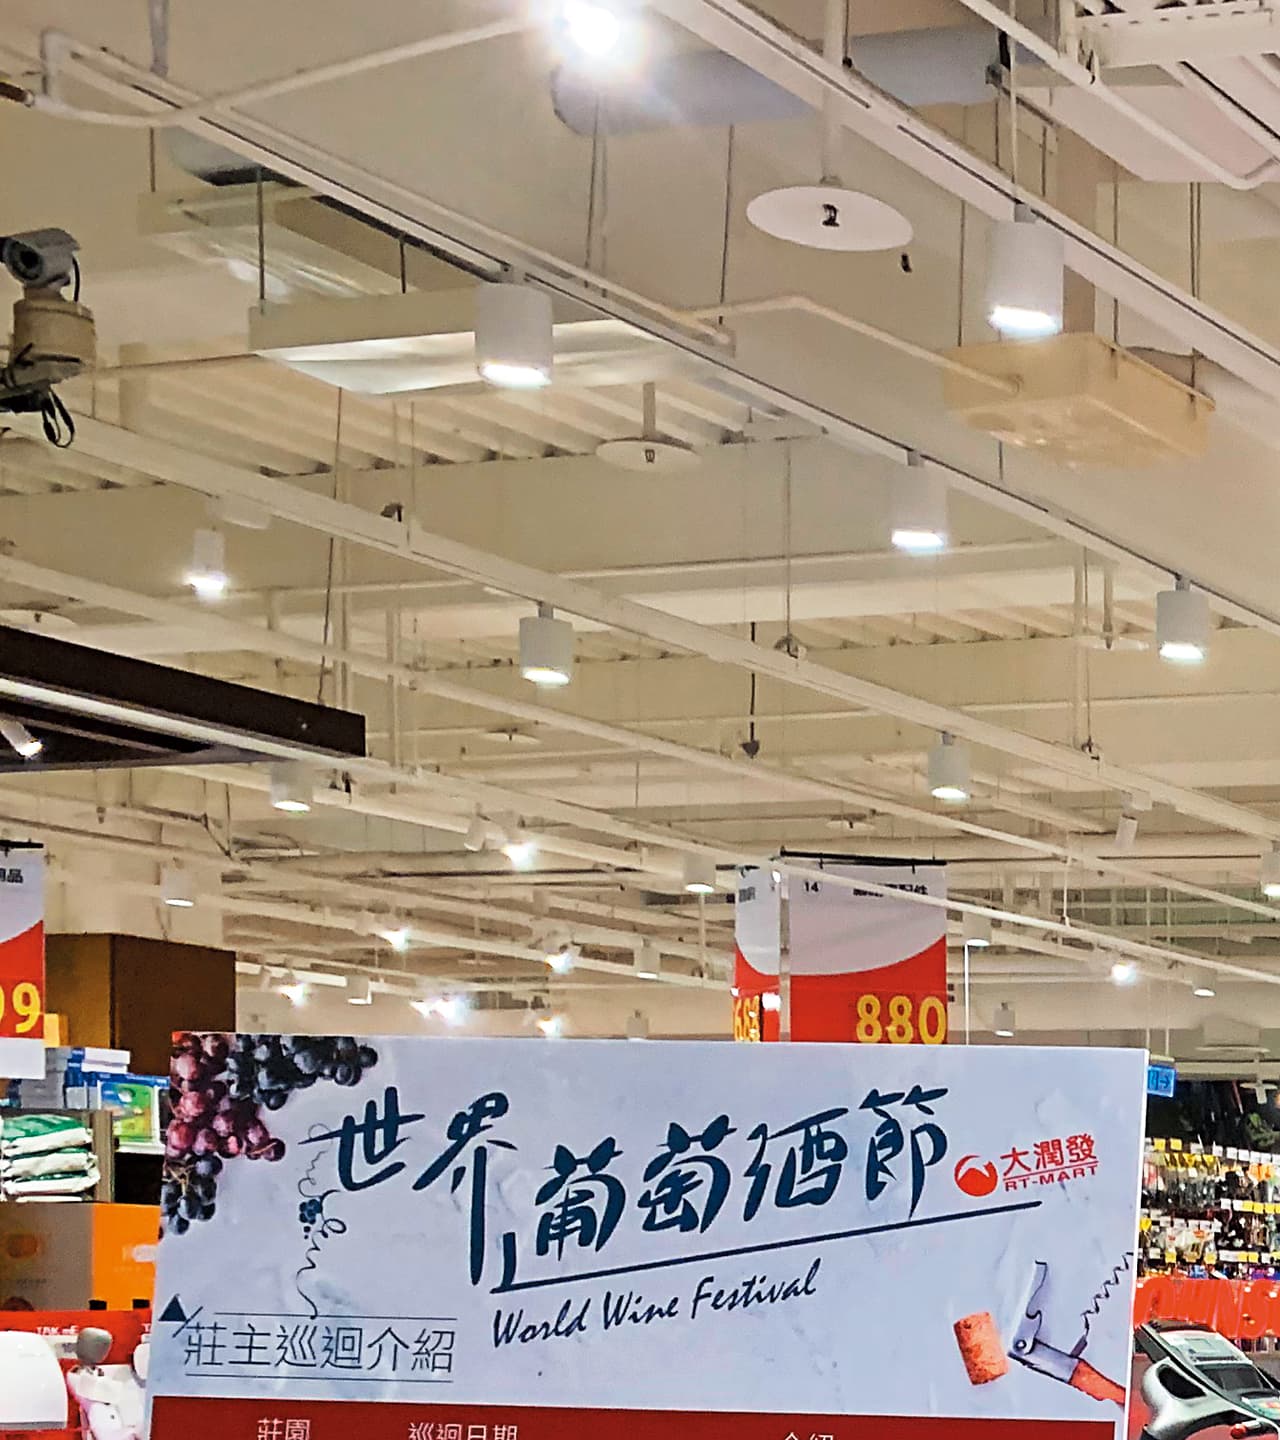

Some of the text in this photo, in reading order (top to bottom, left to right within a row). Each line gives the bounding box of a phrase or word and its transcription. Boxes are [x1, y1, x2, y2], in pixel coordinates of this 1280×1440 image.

[804, 881, 820, 893] 14
[0, 982, 41, 1033] 9
[856, 994, 947, 1044] 880
[1000, 1133, 1099, 1179] 大潤發
[1003, 1161, 1099, 1191] RT-MART
[492, 1262, 818, 1347] World Wine Festival
[181, 1320, 455, 1377] 莊主巡迴介紹
